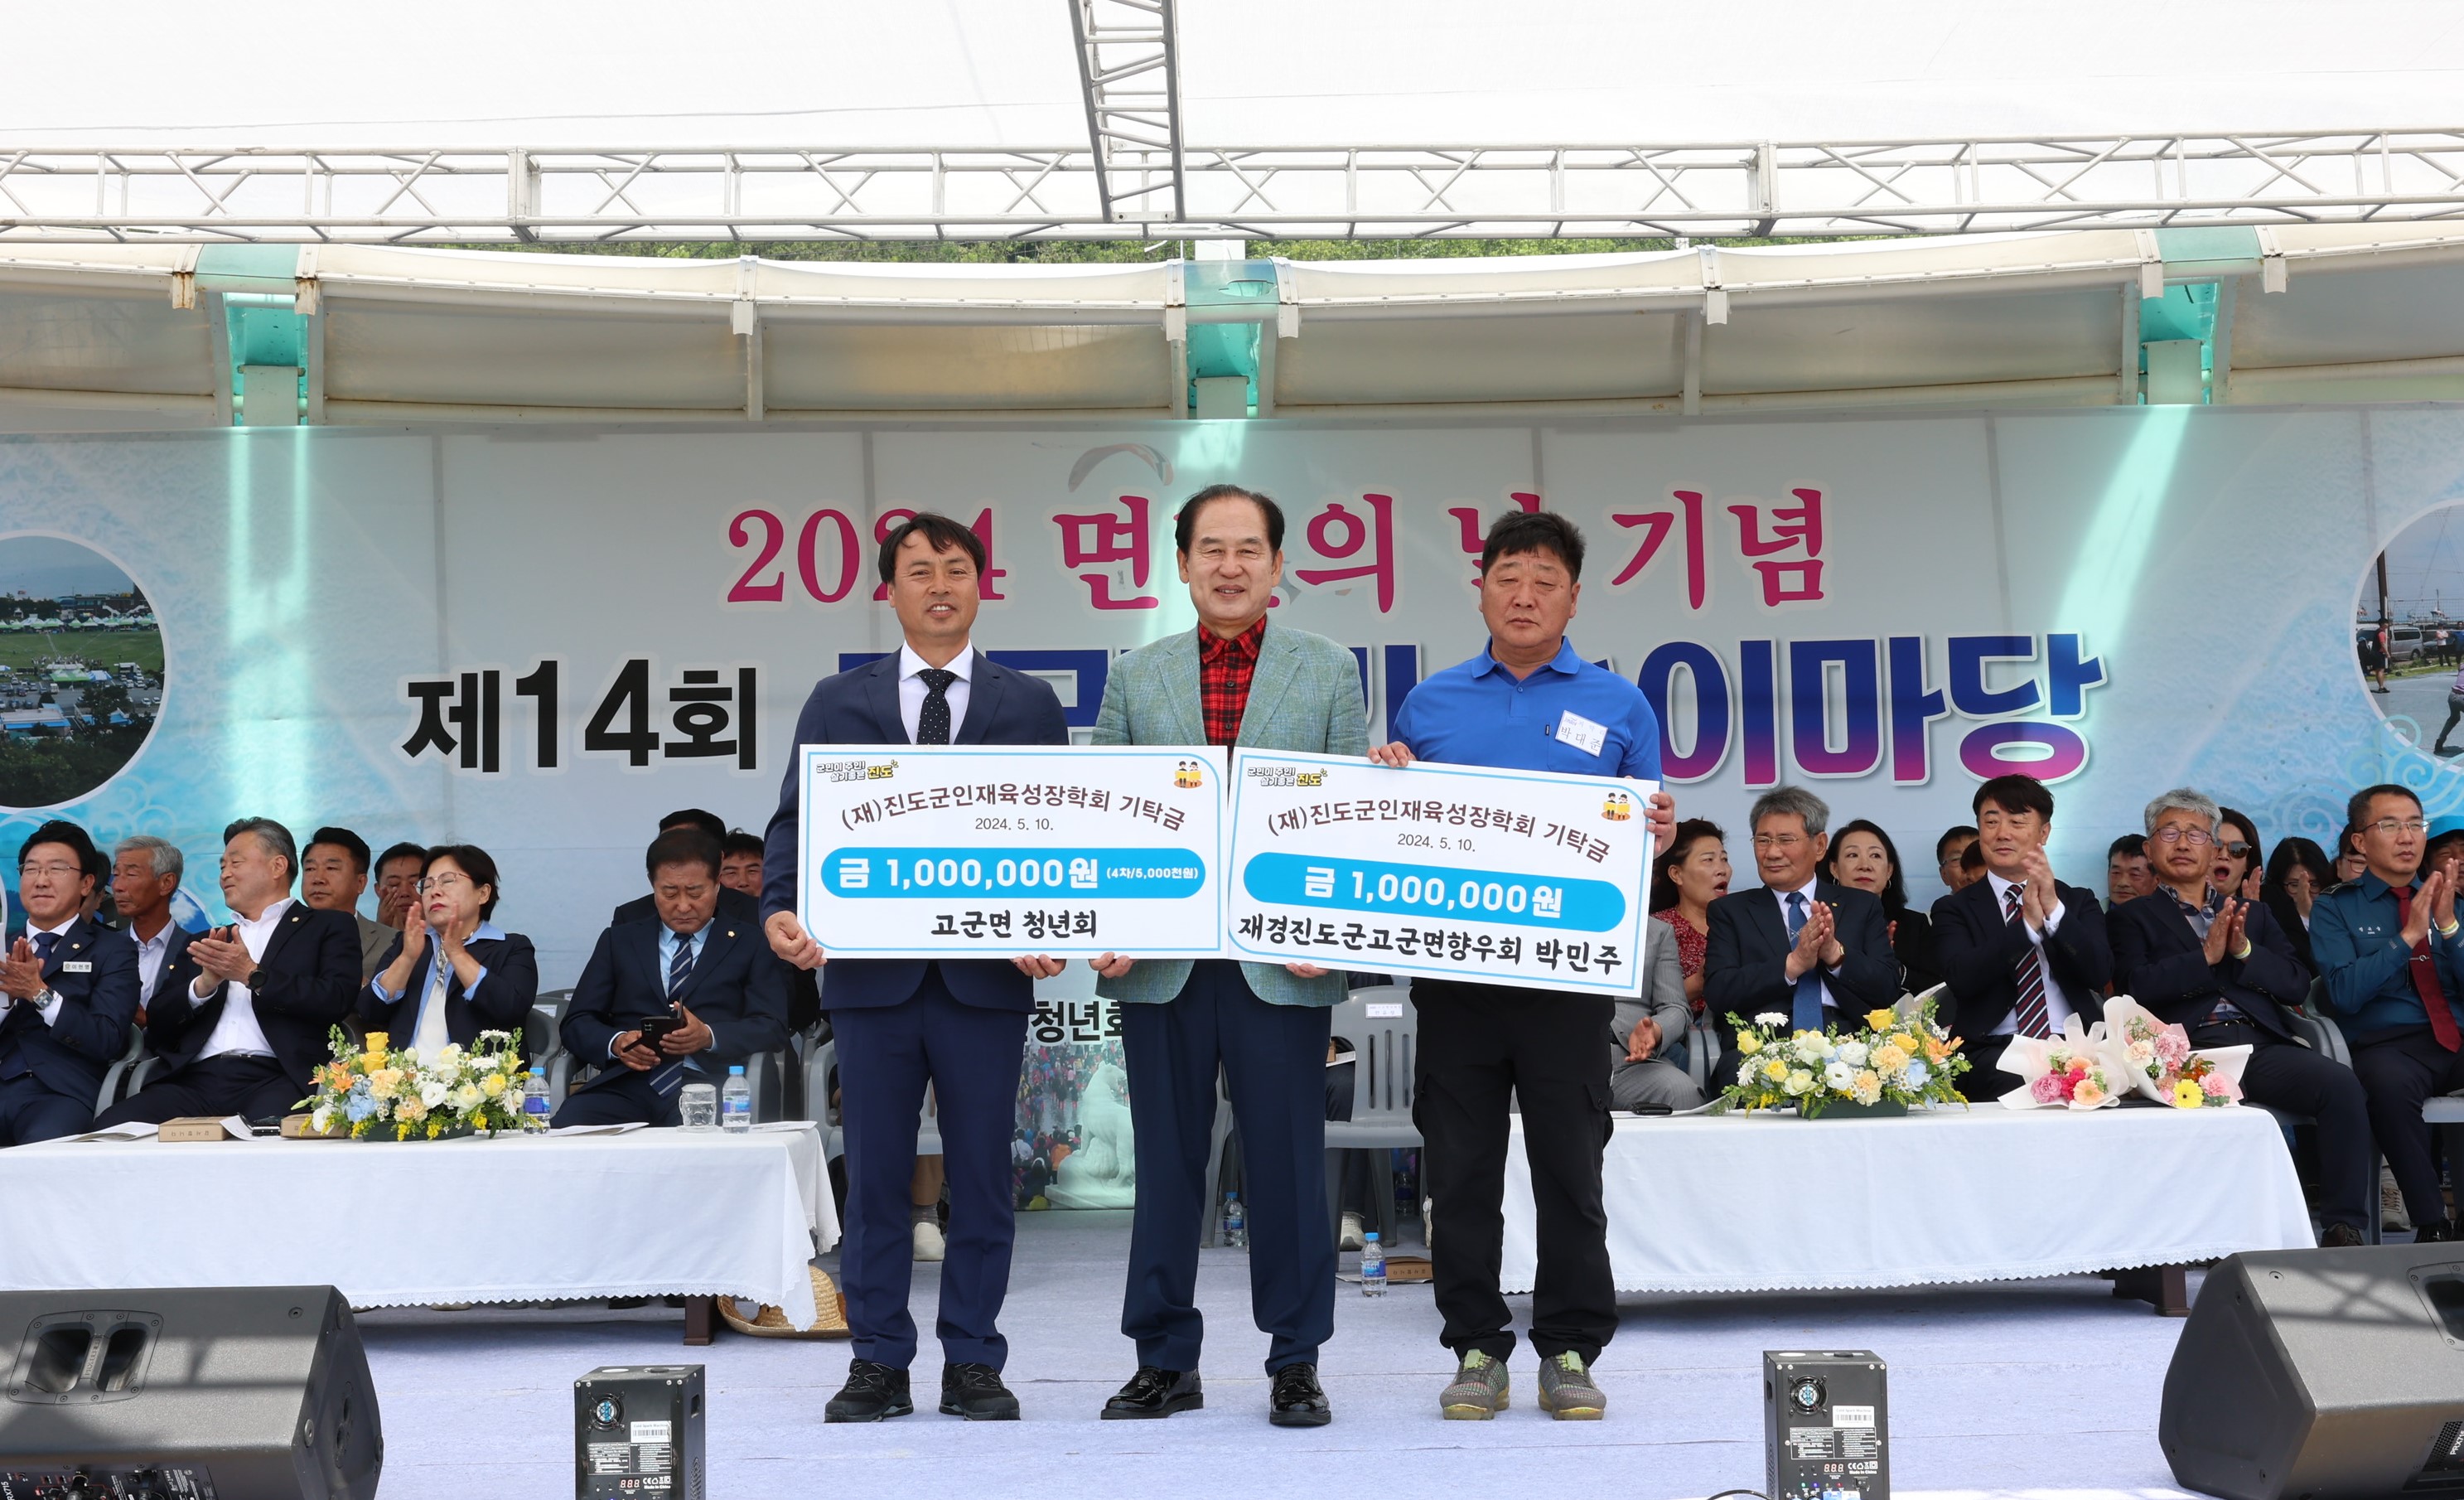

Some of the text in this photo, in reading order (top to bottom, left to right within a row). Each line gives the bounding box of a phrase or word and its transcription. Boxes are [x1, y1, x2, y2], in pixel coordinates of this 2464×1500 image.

[1052, 493, 1394, 613] 면의
[1611, 487, 1824, 611] 기념
[403, 659, 757, 773] 제14회
[1599, 634, 2103, 785] 이마당
[816, 763, 843, 773] 군민이
[867, 766, 893, 779] 진도
[1248, 767, 1273, 777] 군민이
[1297, 773, 1322, 786] 진도
[842, 783, 1186, 831] (재)진도군인재육성장학회 기탁금
[975, 818, 1054, 830] 2024. 5. 10.
[1267, 799, 1611, 864] (재)진도군인재육성장학회 기탁금
[1397, 833, 1476, 853] 2024. 5. 10.
[838, 857, 1199, 890] 금 1,000,000원 (4차/5,000천원)
[1304, 866, 1563, 919] 금 1,000,000원
[930, 909, 1098, 939] 고군면 청년회
[1238, 912, 1623, 976] 재경진도군고군면향우회 박민주
